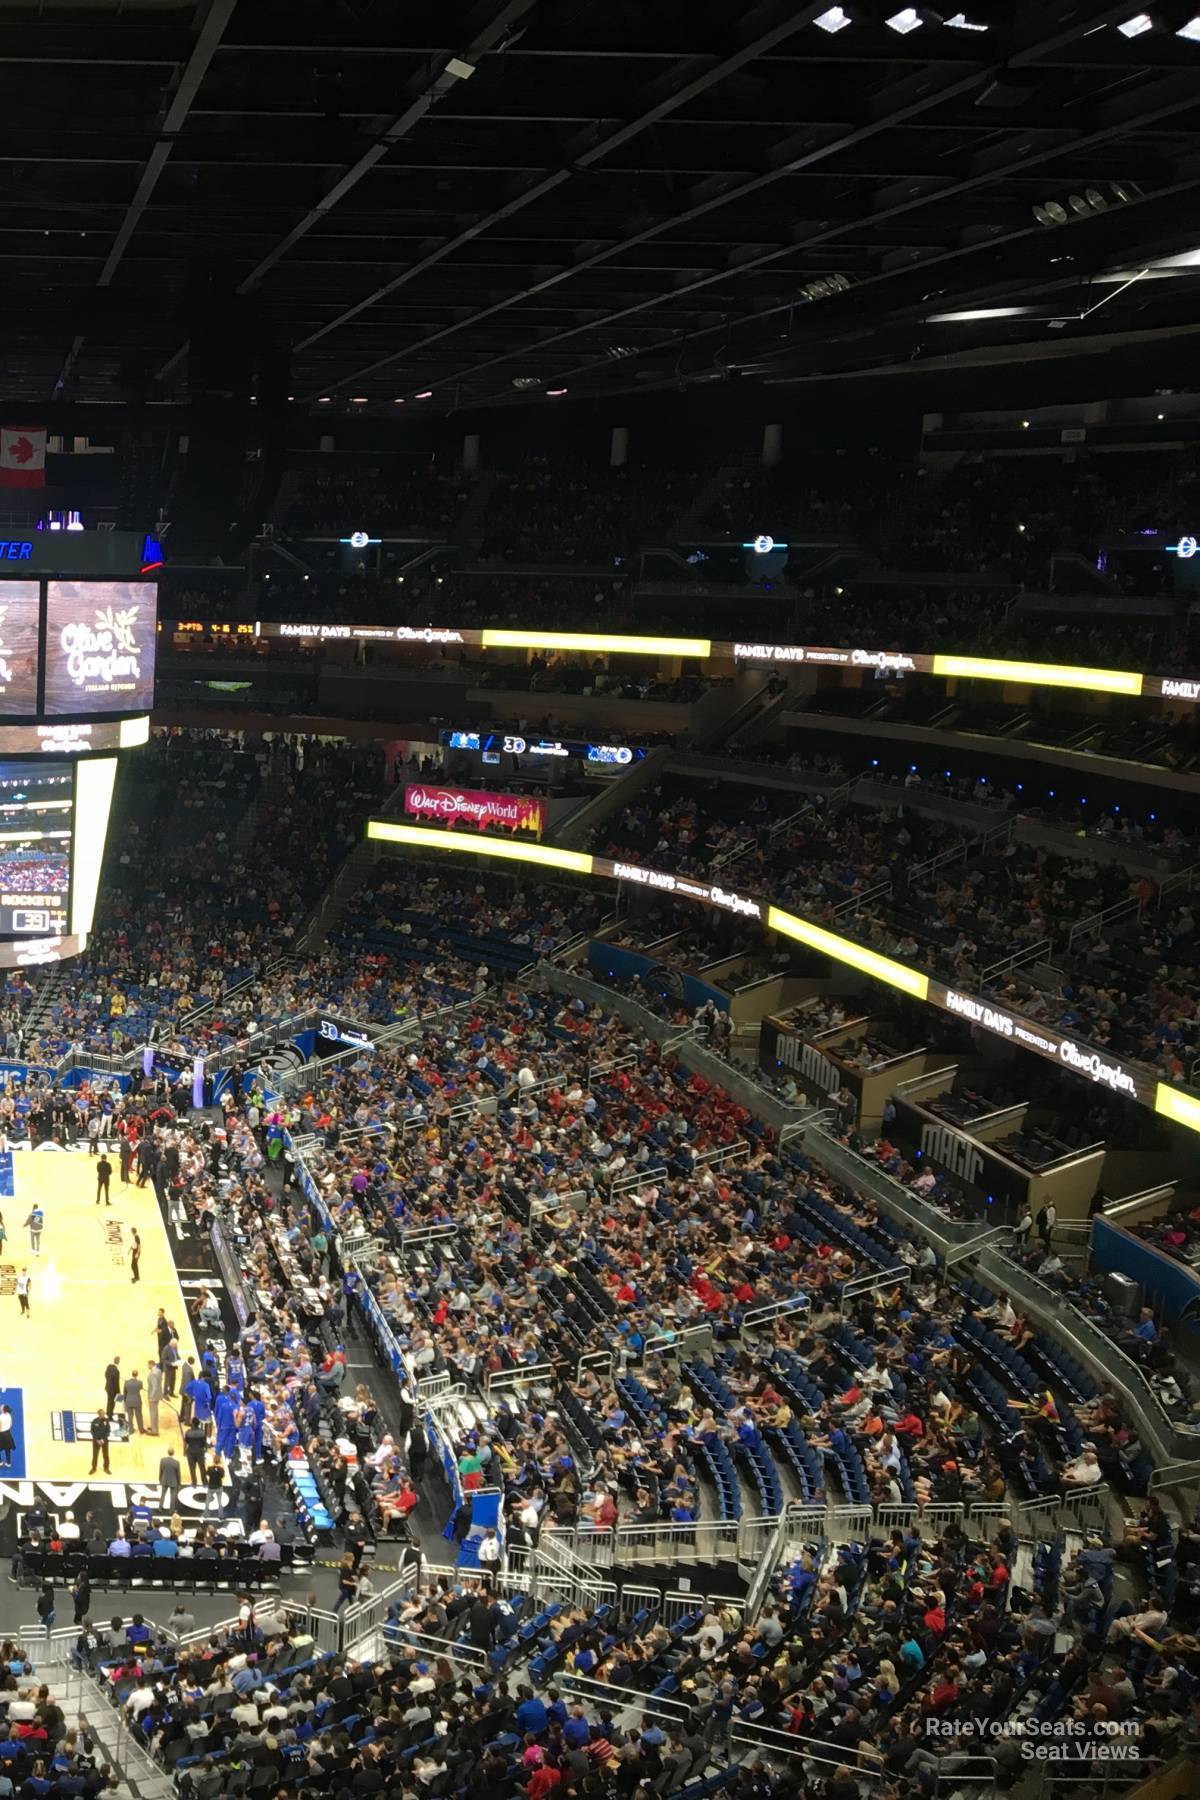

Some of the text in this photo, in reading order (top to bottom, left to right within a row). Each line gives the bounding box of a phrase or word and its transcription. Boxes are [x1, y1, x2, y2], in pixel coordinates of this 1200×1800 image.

[60, 623, 113, 654] Olive
[280, 625, 320, 637] FAMILY
[321, 626, 350, 638] DAYS
[734, 644, 774, 658] FAMILY
[775, 647, 804, 660] DAYS
[67, 652, 140, 684] Garden
[1161, 680, 1200, 698] FAMILY
[487, 802, 517, 818] World
[614, 863, 649, 882] FAMILY
[650, 872, 675, 889] DAYS
[25, 914, 43, 926] 39
[946, 991, 984, 1021] FAMILY
[984, 1008, 1013, 1036] DAYS
[776, 1033, 840, 1094] ORLANDO
[921, 1124, 984, 1184] MAGIC
